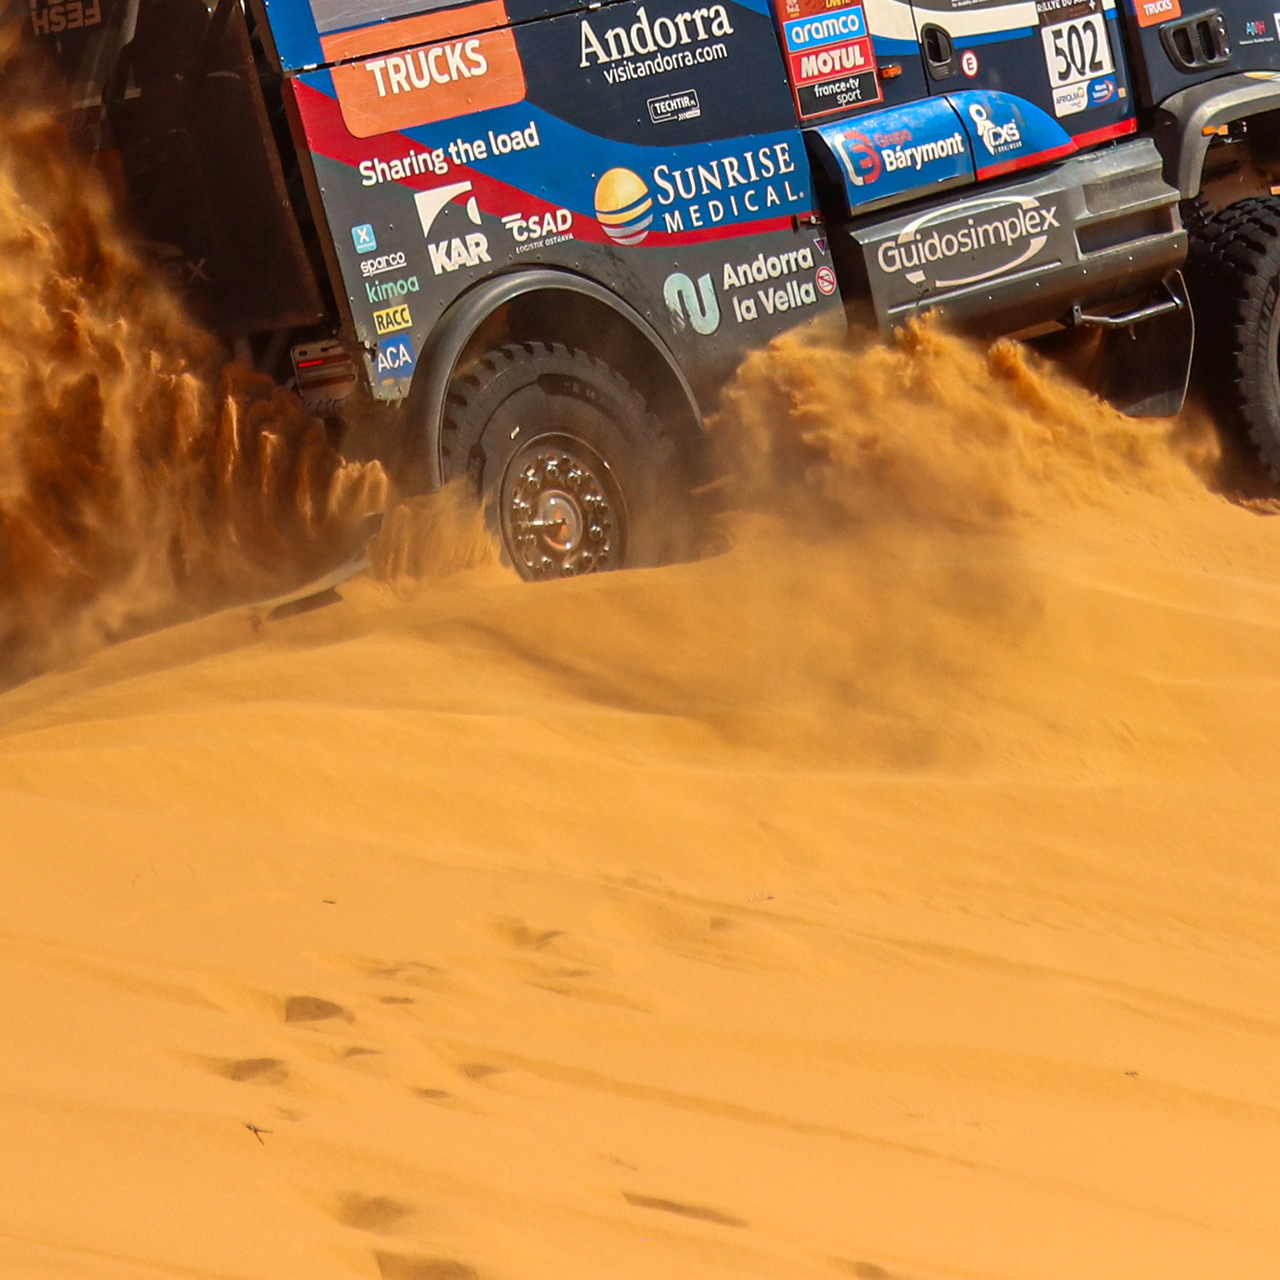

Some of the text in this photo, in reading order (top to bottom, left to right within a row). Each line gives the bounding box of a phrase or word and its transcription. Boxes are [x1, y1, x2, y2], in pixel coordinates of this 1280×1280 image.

[579, 4, 734, 68] Andorra
[791, 14, 860, 44] aramco
[365, 39, 488, 97] TRUCKS
[603, 43, 728, 84] visitandorra.com
[801, 44, 865, 79] MOTUL
[966, 56, 975, 71] E
[1051, 20, 1104, 81] 502
[836, 89, 862, 107] sport
[359, 121, 540, 186] Sharing the load
[881, 132, 965, 172] Bárymont
[990, 122, 1020, 147] CXS
[653, 142, 795, 206] SUNRISE
[427, 232, 492, 275] KAR
[545, 232, 574, 247] OSTRAVA
[878, 206, 1060, 273] Guidosimplex
[360, 251, 406, 276] sparco
[723, 247, 814, 291] Andorra
[365, 275, 420, 304] kimoa
[732, 280, 817, 323] la Vella
[375, 307, 411, 332] RACC
[377, 343, 413, 373] ACA
